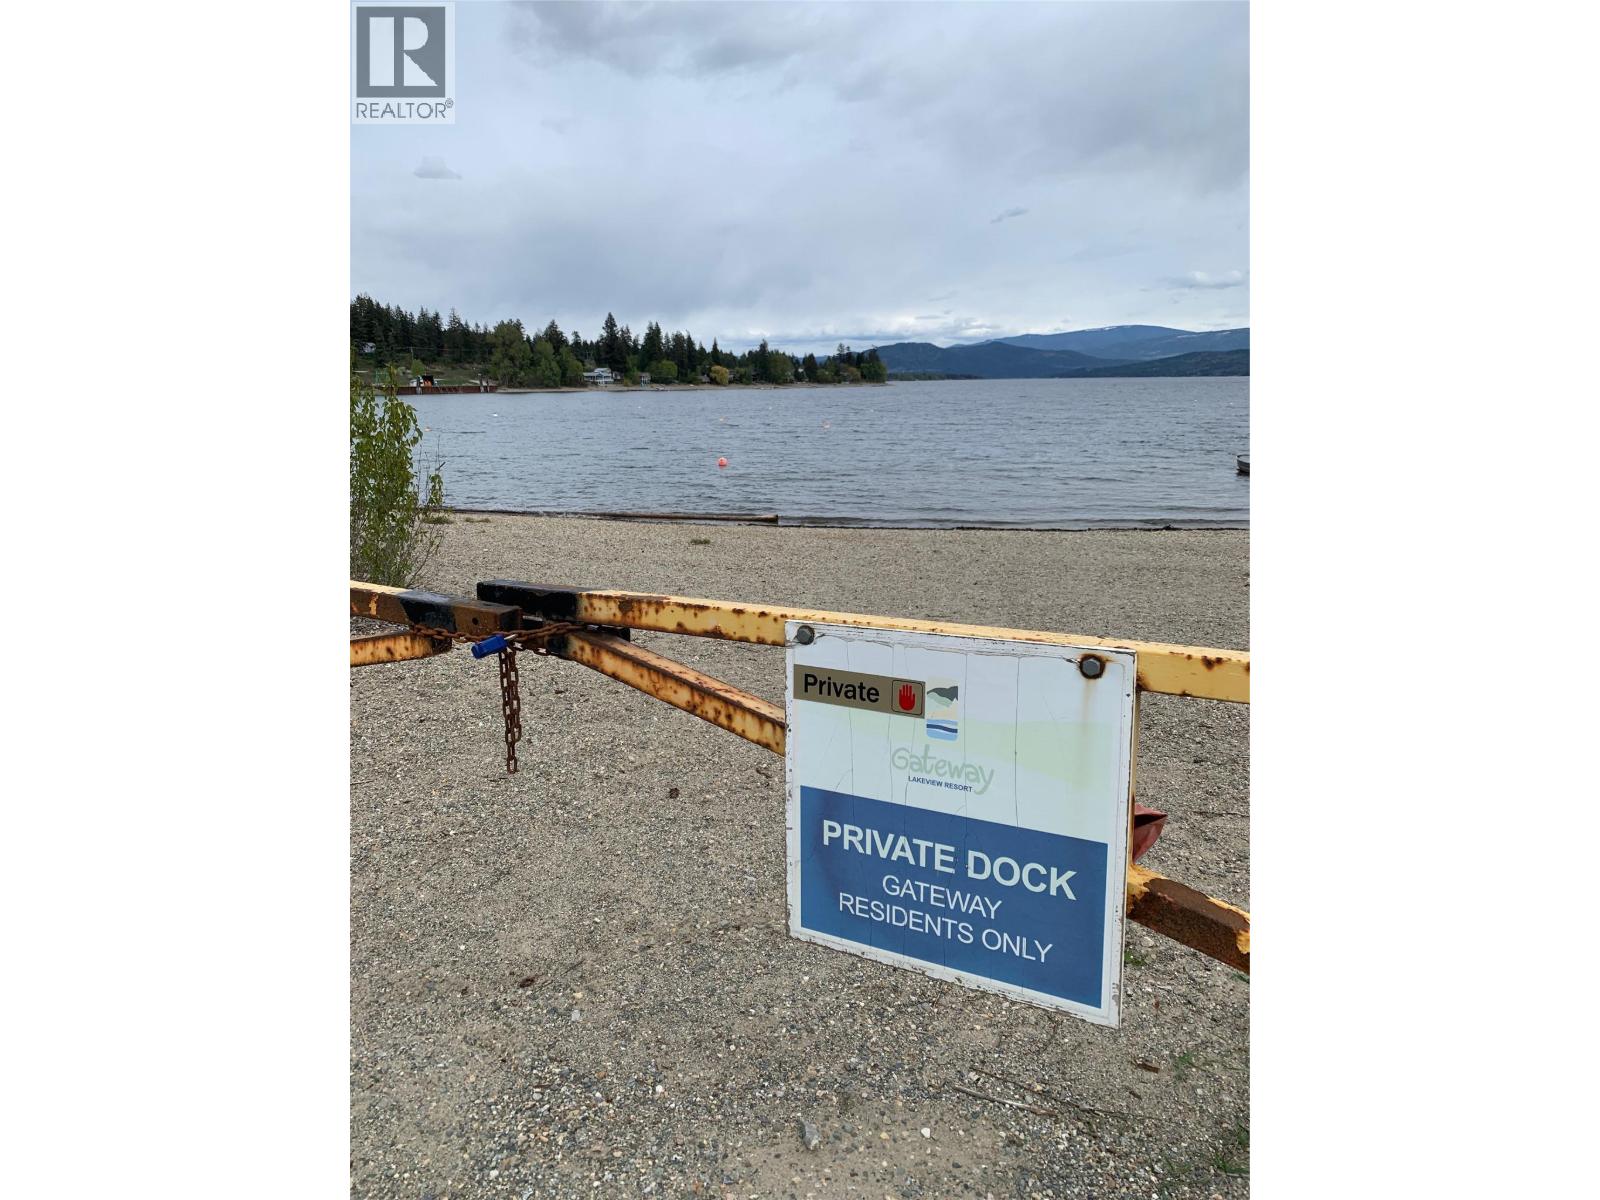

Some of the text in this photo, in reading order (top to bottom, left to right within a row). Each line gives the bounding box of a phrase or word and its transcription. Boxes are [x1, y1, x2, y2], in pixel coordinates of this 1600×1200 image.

[804, 673, 880, 703] Private
[891, 744, 995, 795] Gateway
[908, 775, 973, 793] LAKEVIEW RESORT
[822, 819, 1078, 901] PRIVATE DOCK
[882, 874, 1003, 920] GATEWAY
[839, 892, 1053, 963] RESIDENTS ONLY
